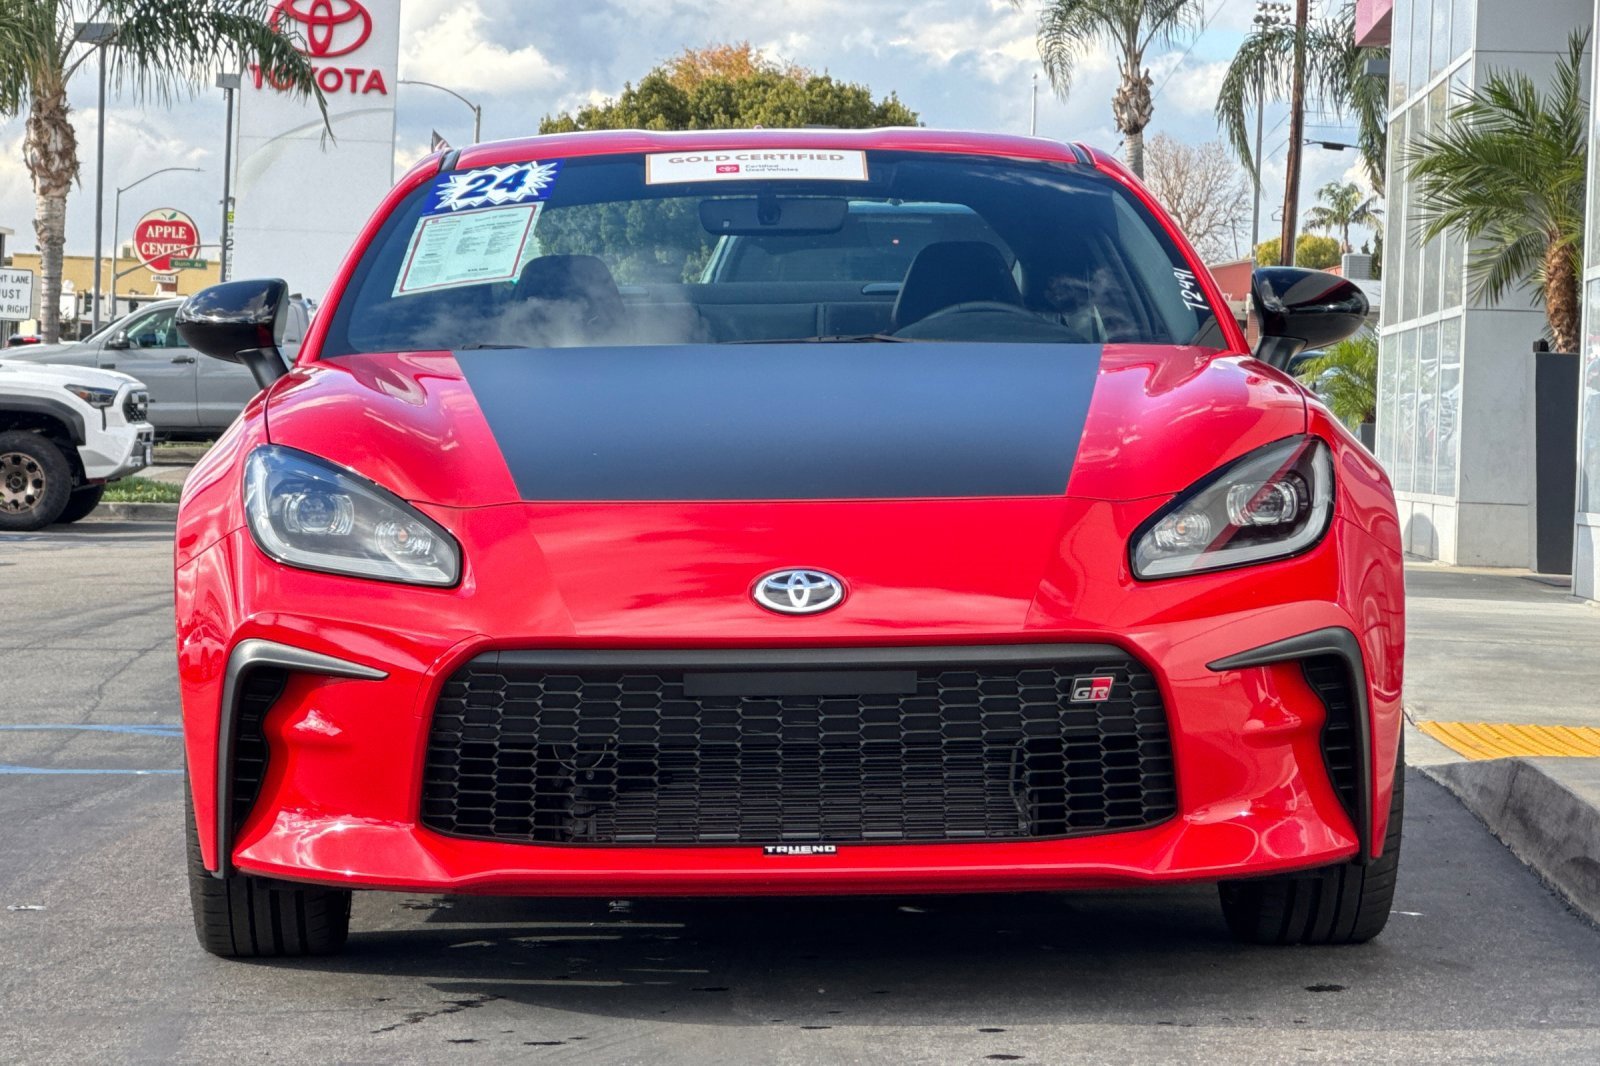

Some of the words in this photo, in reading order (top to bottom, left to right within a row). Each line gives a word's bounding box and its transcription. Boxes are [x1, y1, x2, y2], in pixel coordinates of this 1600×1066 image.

[668, 154, 730, 164] GOLD
[735, 153, 844, 161] CERTIFIED
[456, 169, 531, 200] 24
[146, 225, 187, 239] APPLE
[141, 242, 189, 257] CENTER
[11, 275, 30, 284] LANE
[7, 304, 28, 313] RIGHT
[1073, 687, 1109, 699] GR
[764, 845, 836, 854] TRUENO
